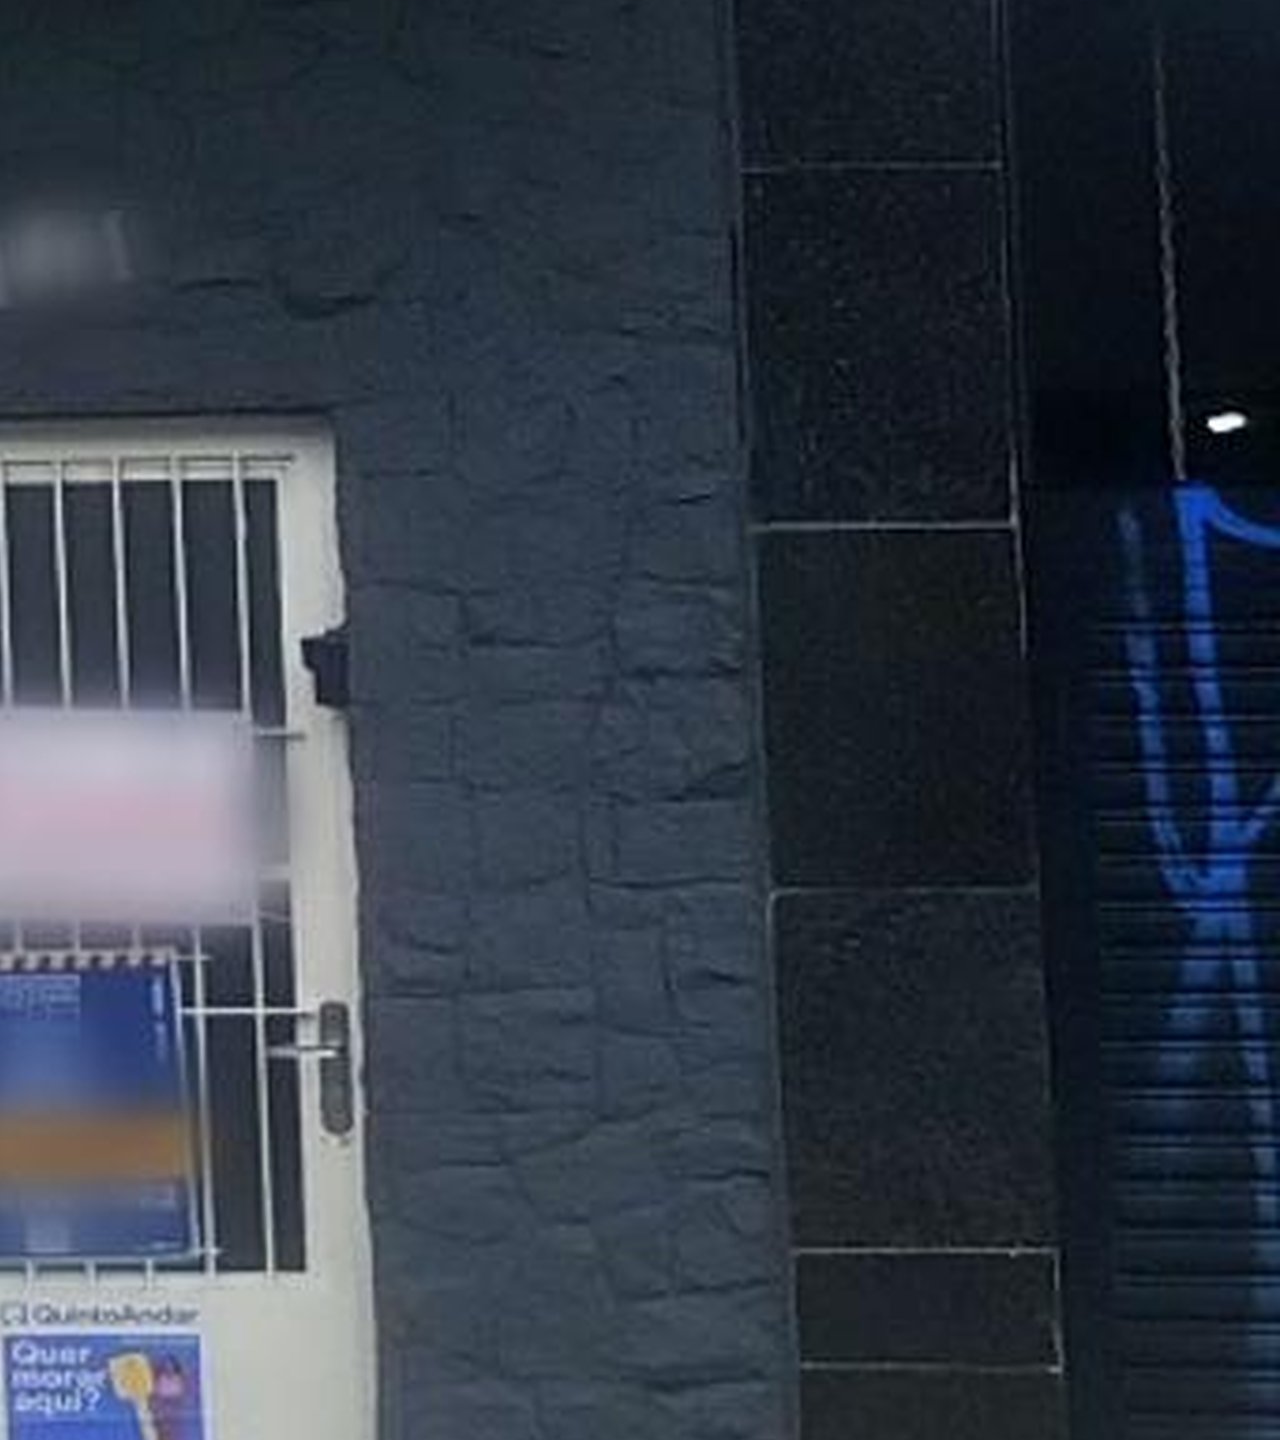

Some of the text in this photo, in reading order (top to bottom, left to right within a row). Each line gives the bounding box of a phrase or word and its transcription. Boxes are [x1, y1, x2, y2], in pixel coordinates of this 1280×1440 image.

[11, 1339, 92, 1366] Quer
[11, 1368, 107, 1389] morar
[14, 1386, 102, 1417] aqui?
